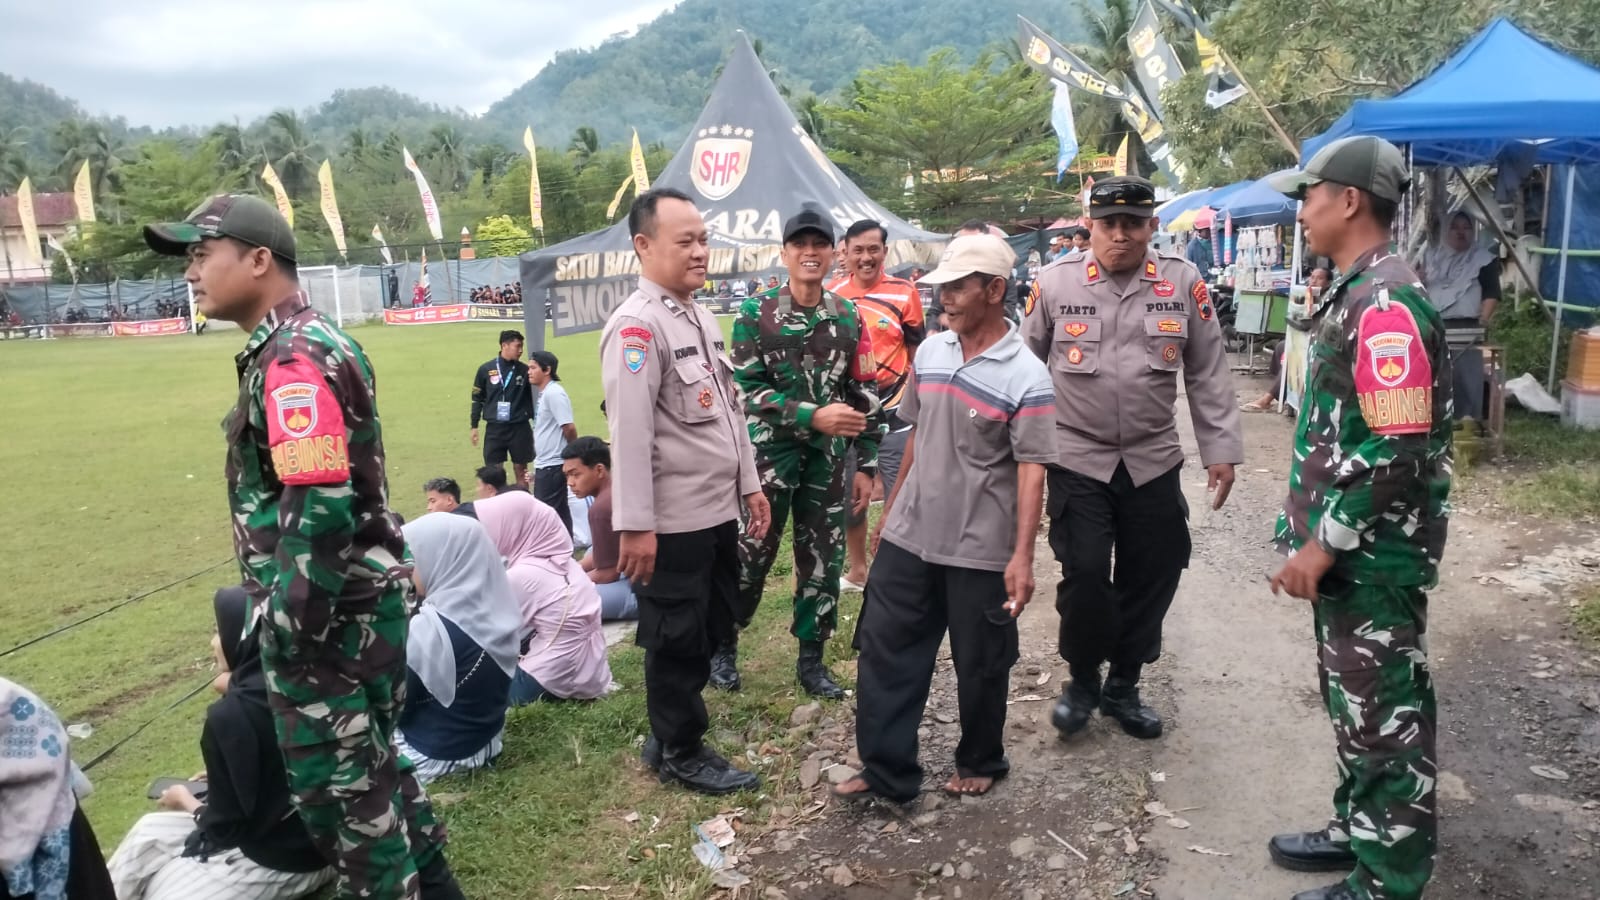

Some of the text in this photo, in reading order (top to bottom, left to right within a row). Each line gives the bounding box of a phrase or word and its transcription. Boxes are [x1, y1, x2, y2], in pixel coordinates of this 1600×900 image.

[699, 150, 741, 187] SHR
[554, 253, 600, 282] SATU
[1059, 304, 1097, 316] TARTO
[1145, 301, 1185, 313] POLRI
[270, 434, 349, 480] ABINSA
